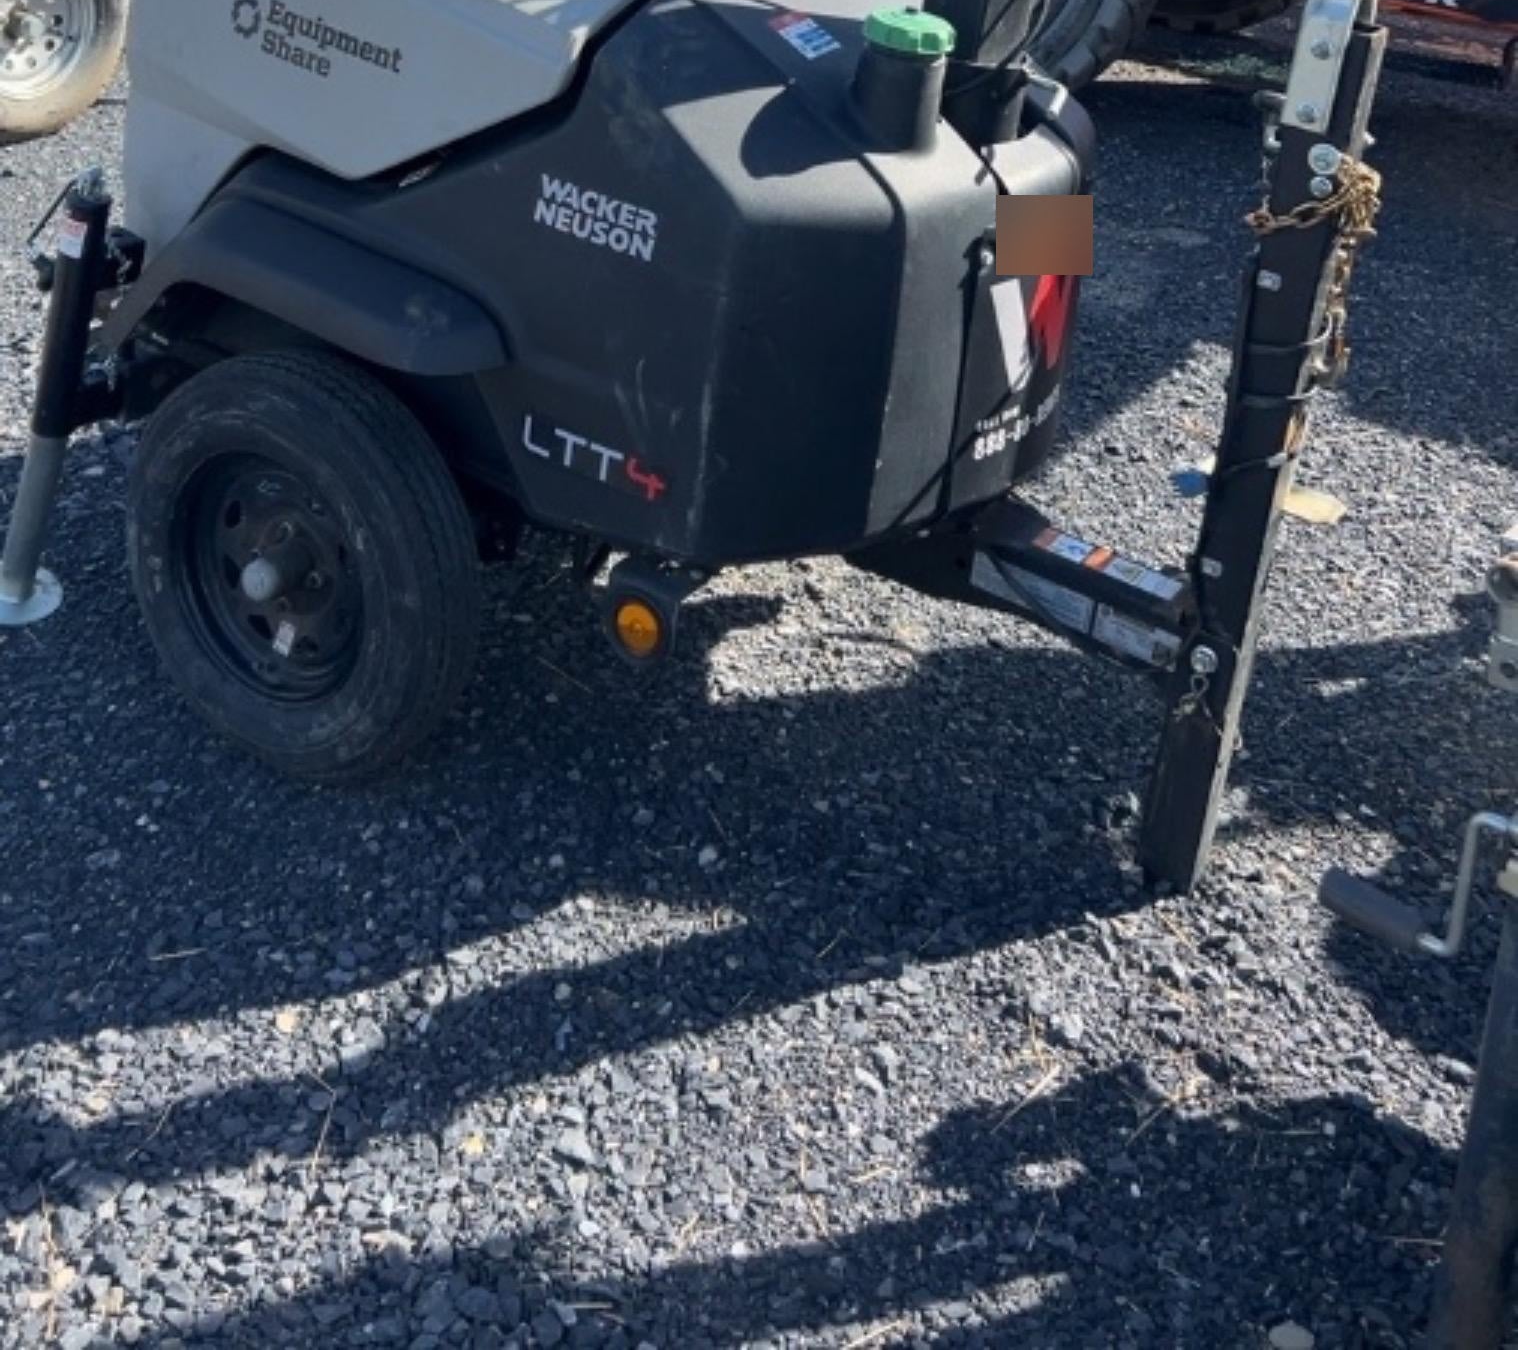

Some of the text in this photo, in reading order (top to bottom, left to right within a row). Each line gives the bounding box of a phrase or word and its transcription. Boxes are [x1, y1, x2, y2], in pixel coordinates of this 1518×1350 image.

[261, 29, 331, 78] Share
[533, 197, 656, 262] NEUSON
[541, 173, 658, 236] WACKER
[523, 414, 667, 501] LTT4
